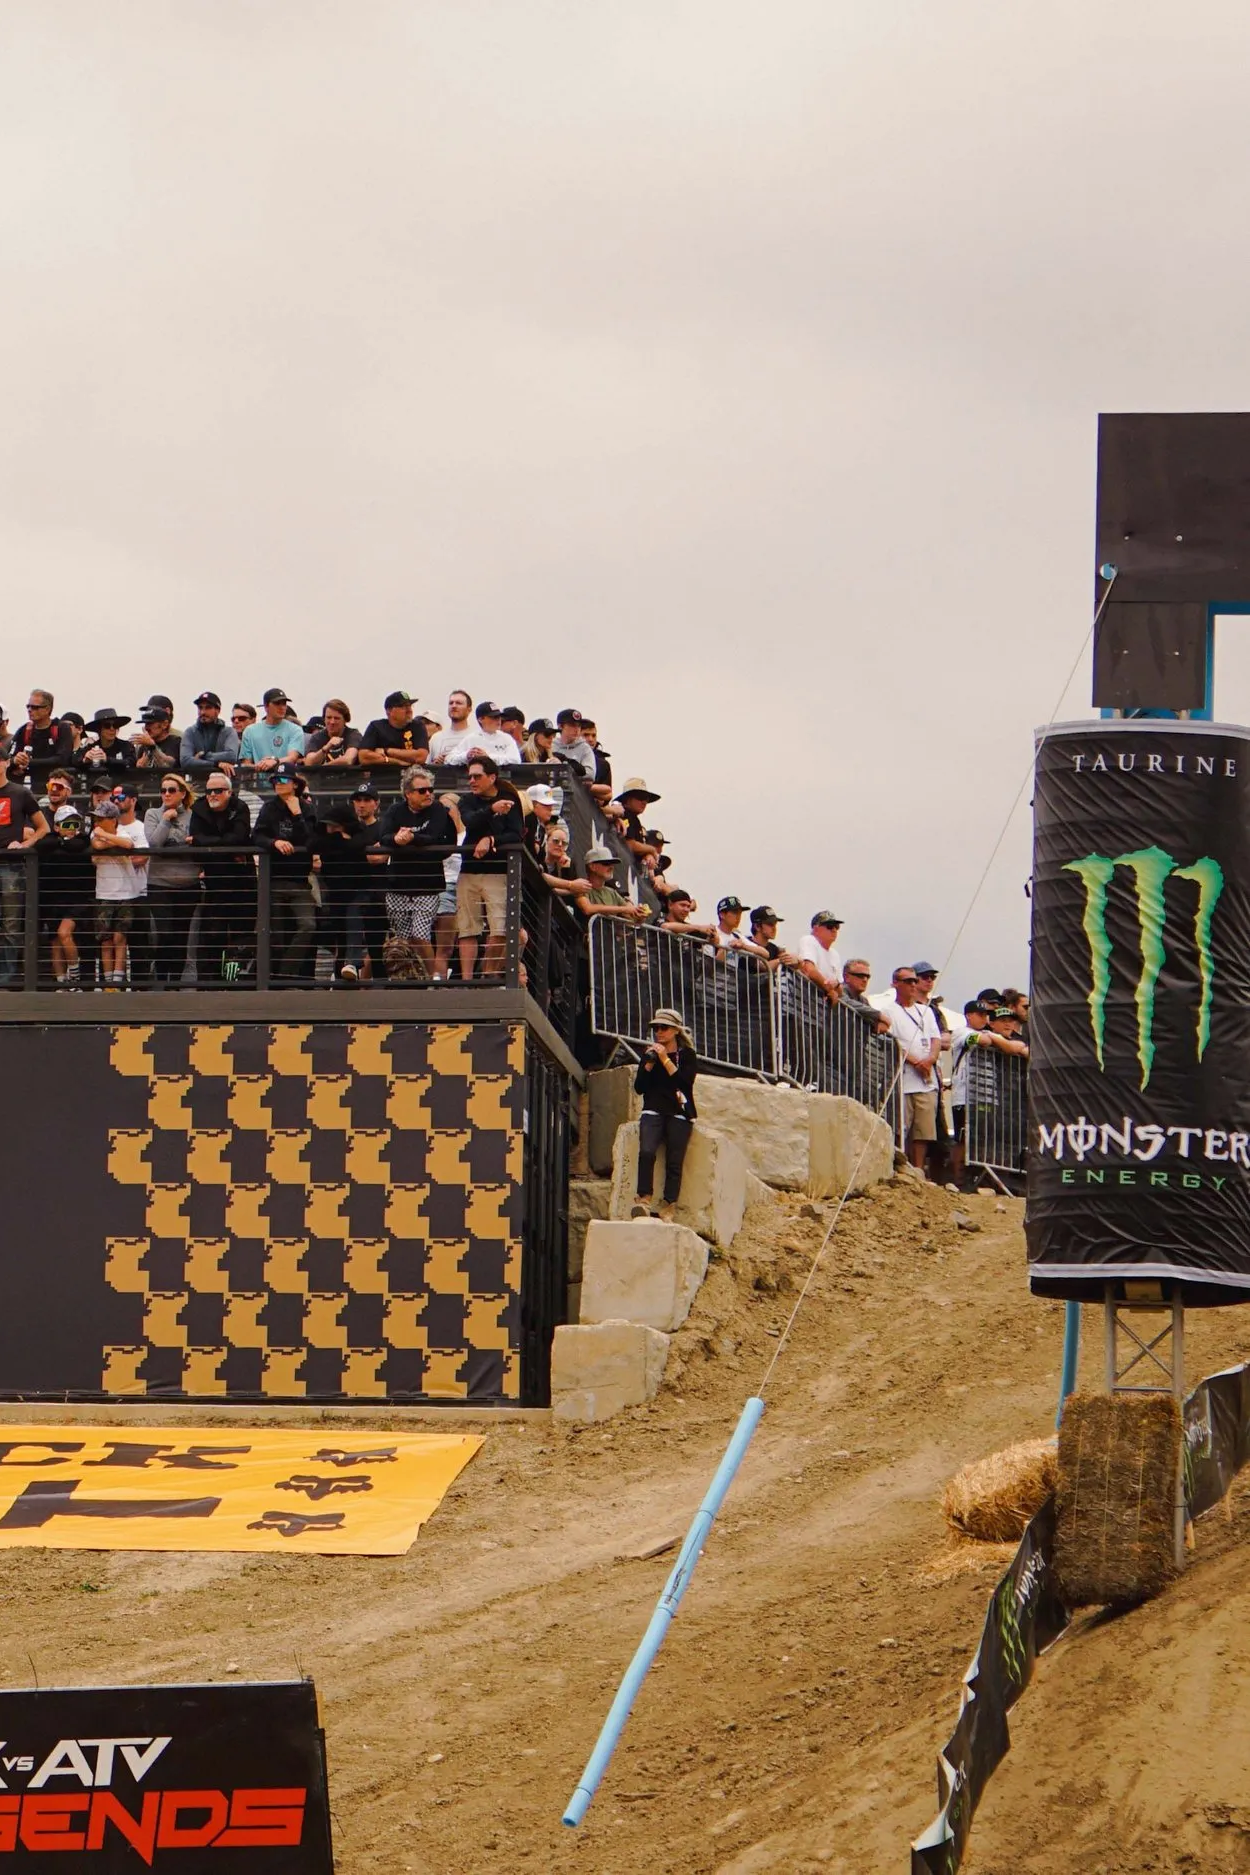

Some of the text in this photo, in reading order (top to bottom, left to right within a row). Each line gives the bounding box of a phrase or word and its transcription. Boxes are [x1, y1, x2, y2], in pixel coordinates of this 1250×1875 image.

[1072, 753, 1237, 778] TAURINE
[1038, 1116, 1250, 1169] MONSTER
[1062, 1169, 1226, 1191] ENERGY
[27, 1736, 173, 1789] ATV
